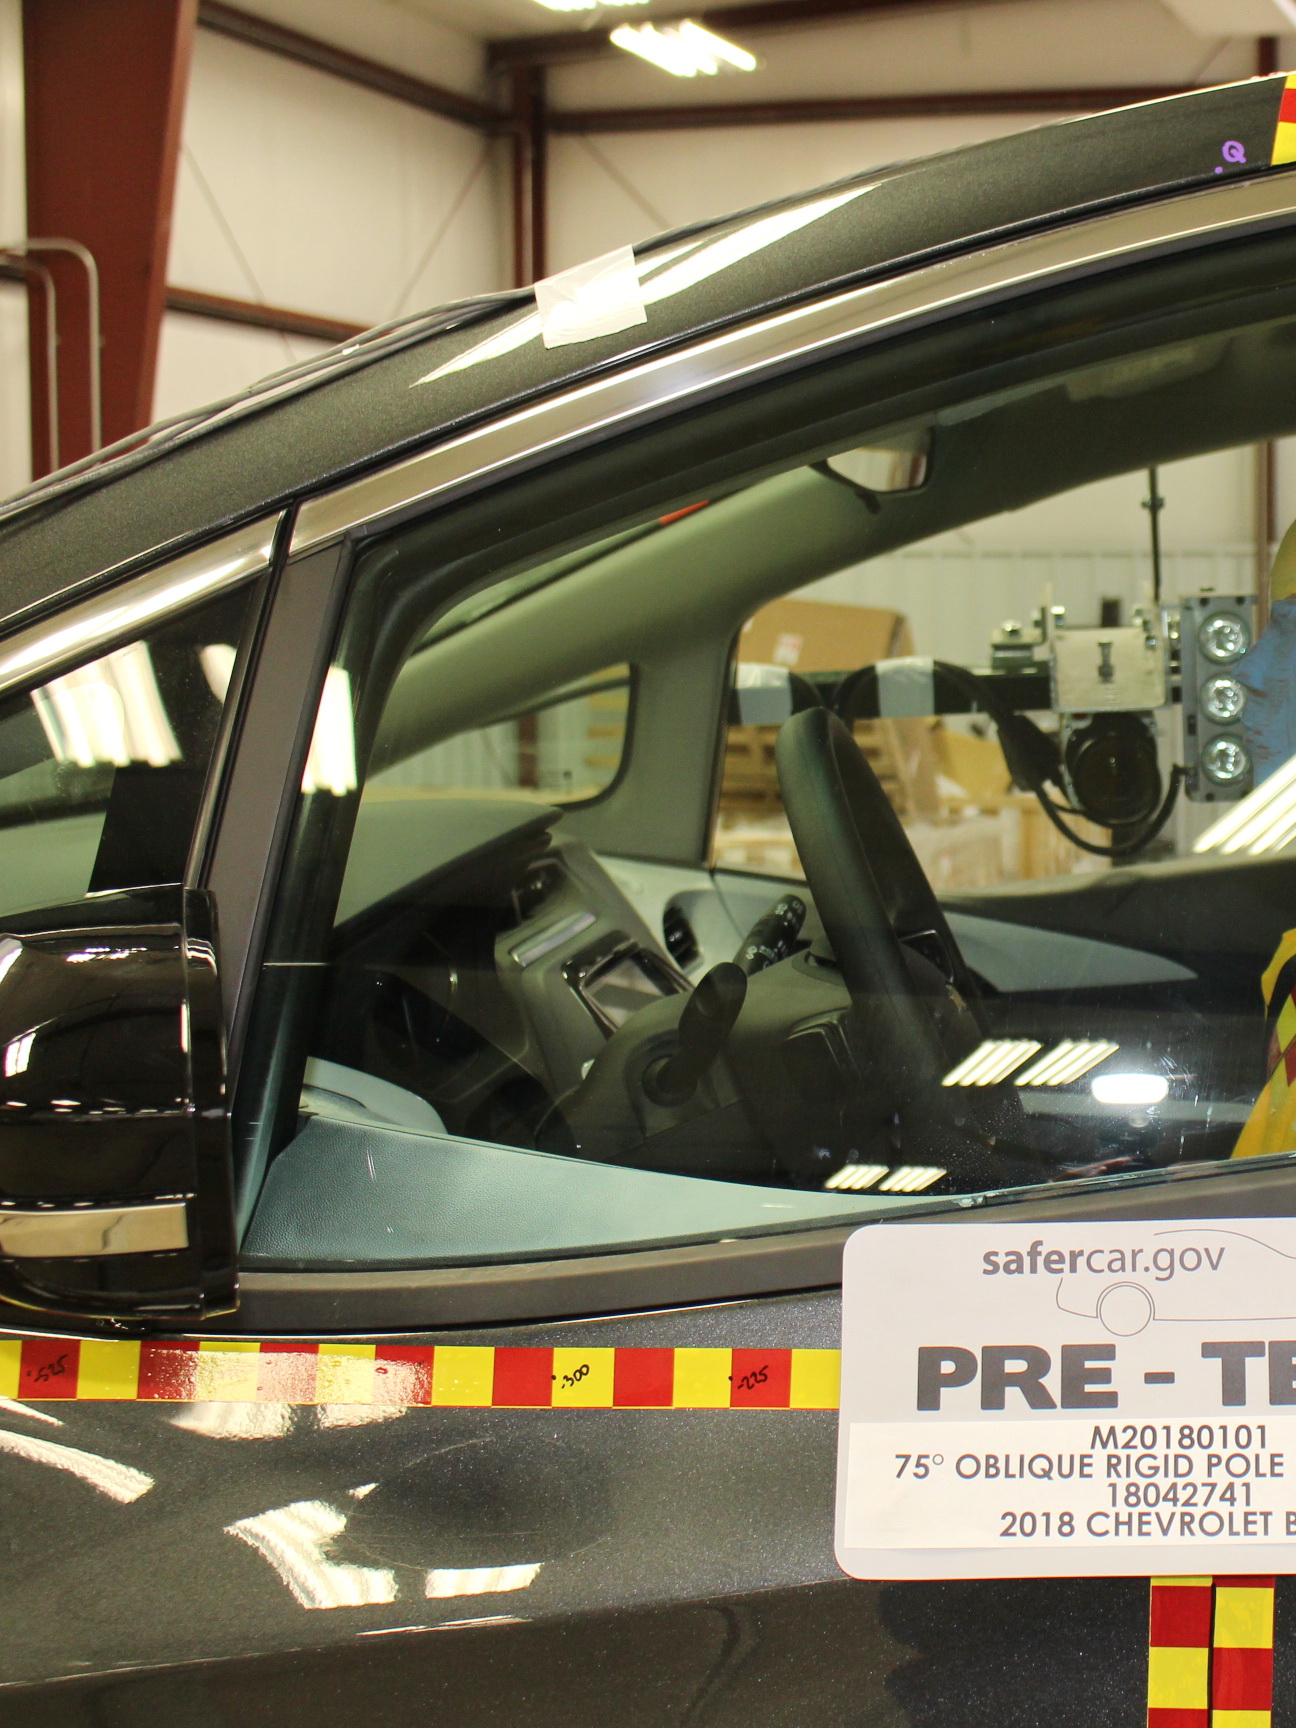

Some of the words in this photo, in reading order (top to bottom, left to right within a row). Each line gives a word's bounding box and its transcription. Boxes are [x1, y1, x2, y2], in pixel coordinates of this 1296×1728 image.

[982, 1240, 1226, 1282] safercar.gov
[917, 1343, 1119, 1411] PRE
[1144, 1371, 1176, 1385] -
[1090, 1424, 1268, 1451] M20180101
[895, 1454, 944, 1480] 75°
[955, 1453, 1094, 1481] OBLIQUE
[1105, 1453, 1195, 1479] RIGID
[1207, 1453, 1285, 1478] POLE
[1108, 1481, 1252, 1508] 18042741
[999, 1511, 1075, 1538] 2018
[1086, 1511, 1273, 1537] CHEVROLET
